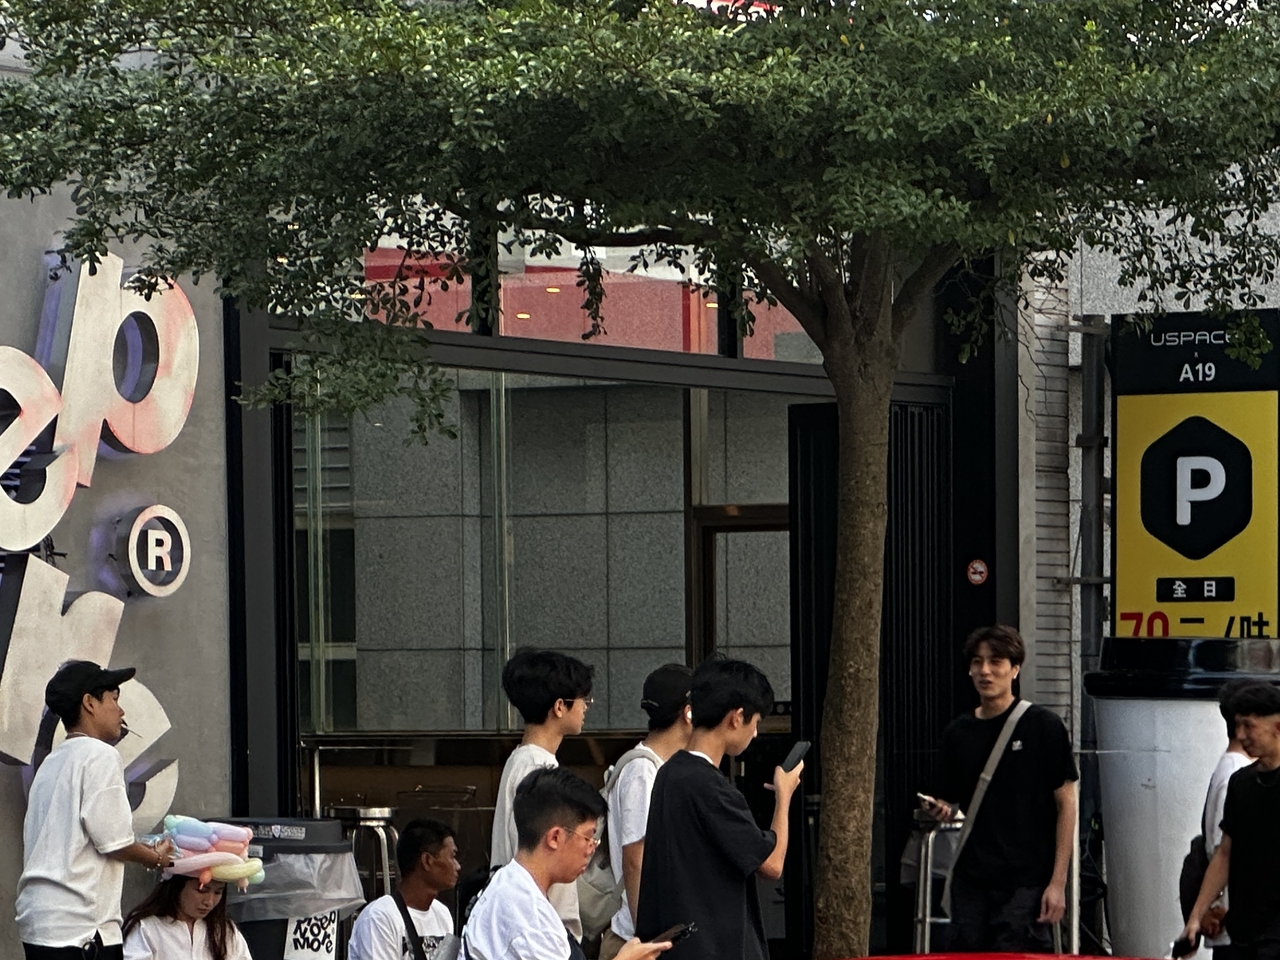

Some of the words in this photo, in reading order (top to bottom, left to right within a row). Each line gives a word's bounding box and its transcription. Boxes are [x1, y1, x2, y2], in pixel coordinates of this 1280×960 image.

[1179, 362, 1217, 382] A19
[1175, 455, 1227, 527] P
[1172, 580, 1218, 598] 全日
